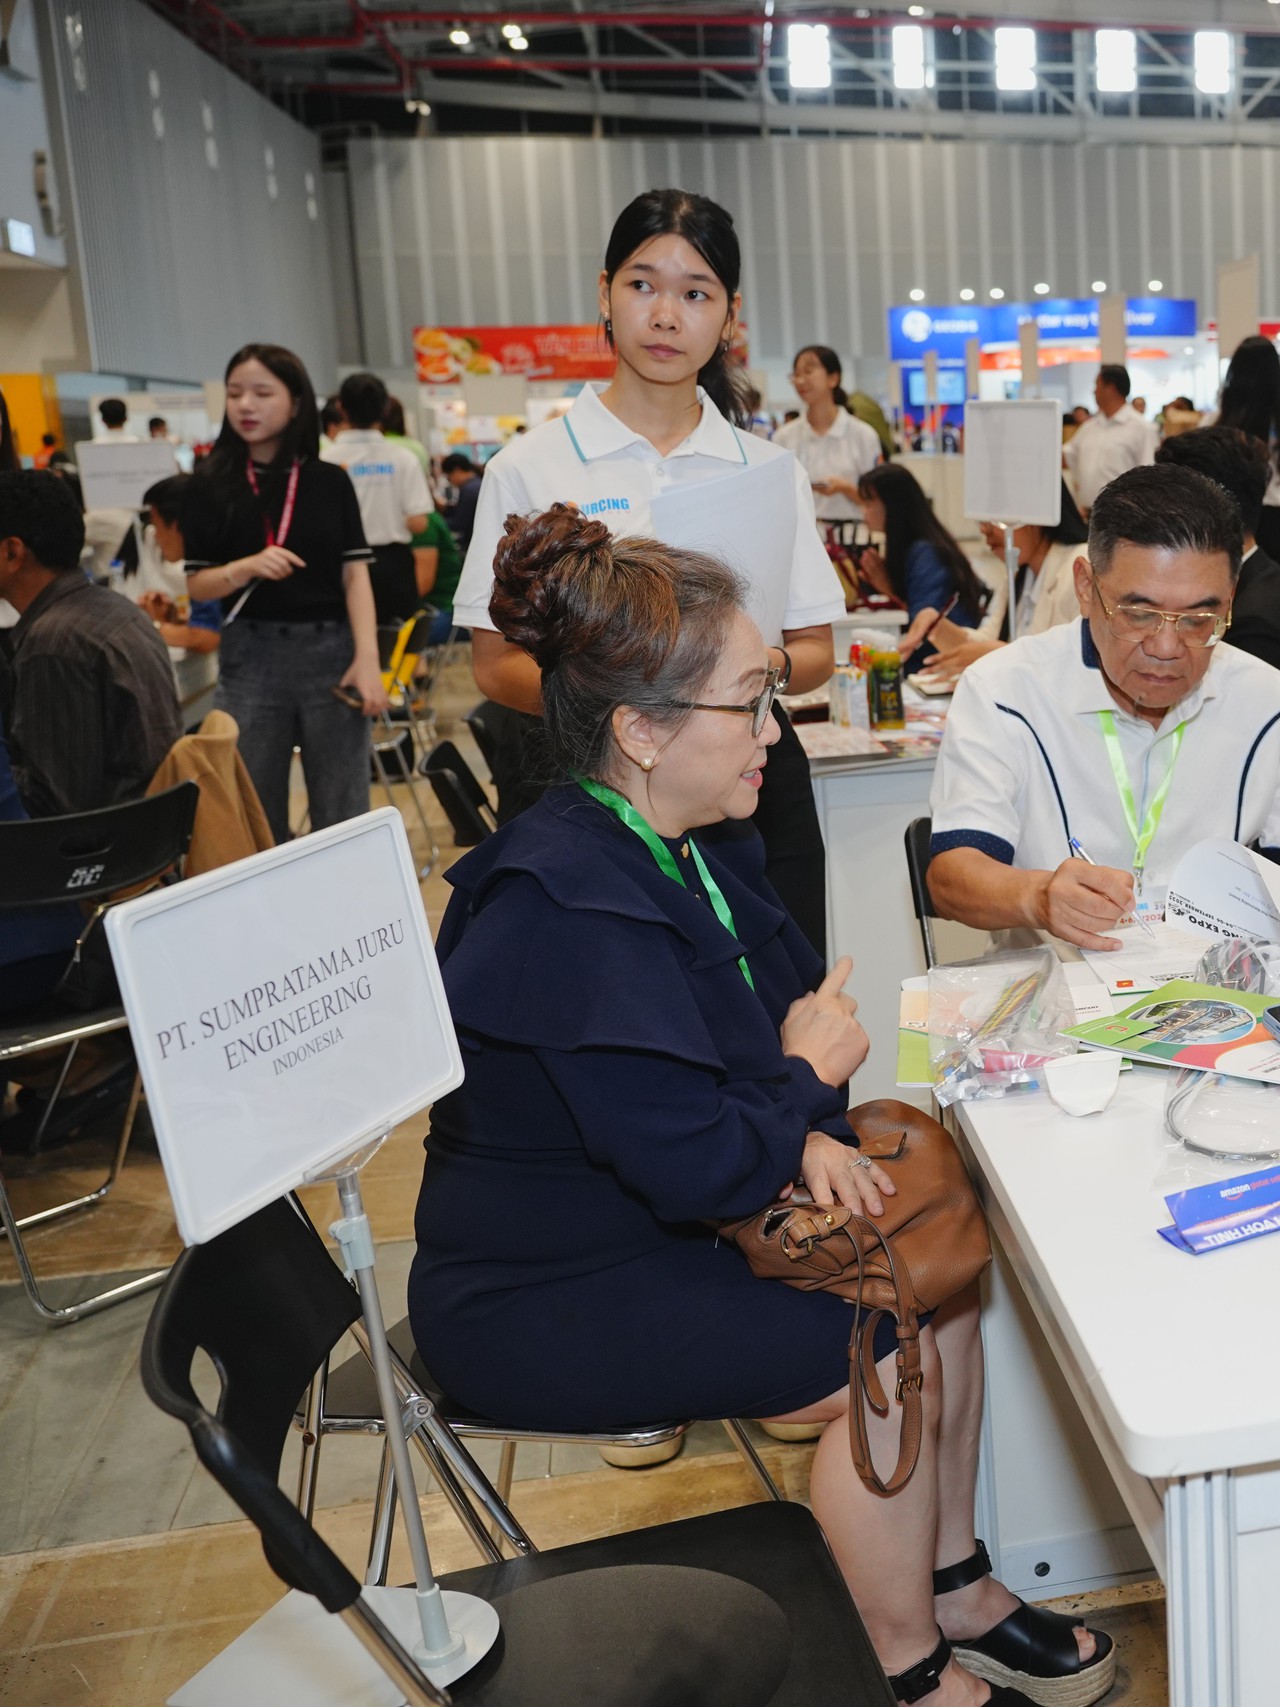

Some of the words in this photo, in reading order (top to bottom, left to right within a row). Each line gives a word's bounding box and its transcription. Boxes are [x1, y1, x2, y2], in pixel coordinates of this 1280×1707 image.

[580, 498, 630, 516] URCING
[1187, 914, 1222, 934] EXPO
[155, 1020, 196, 1061] PT.
[199, 946, 355, 1039] SUMPRATAMA
[355, 918, 405, 965] JURU
[223, 974, 373, 1072] ENGINEERING
[272, 1026, 345, 1076] INDONESIA
[1220, 1183, 1251, 1198] amazon
[1203, 1228, 1242, 1246] TINH
[1241, 1218, 1275, 1237] HOA
